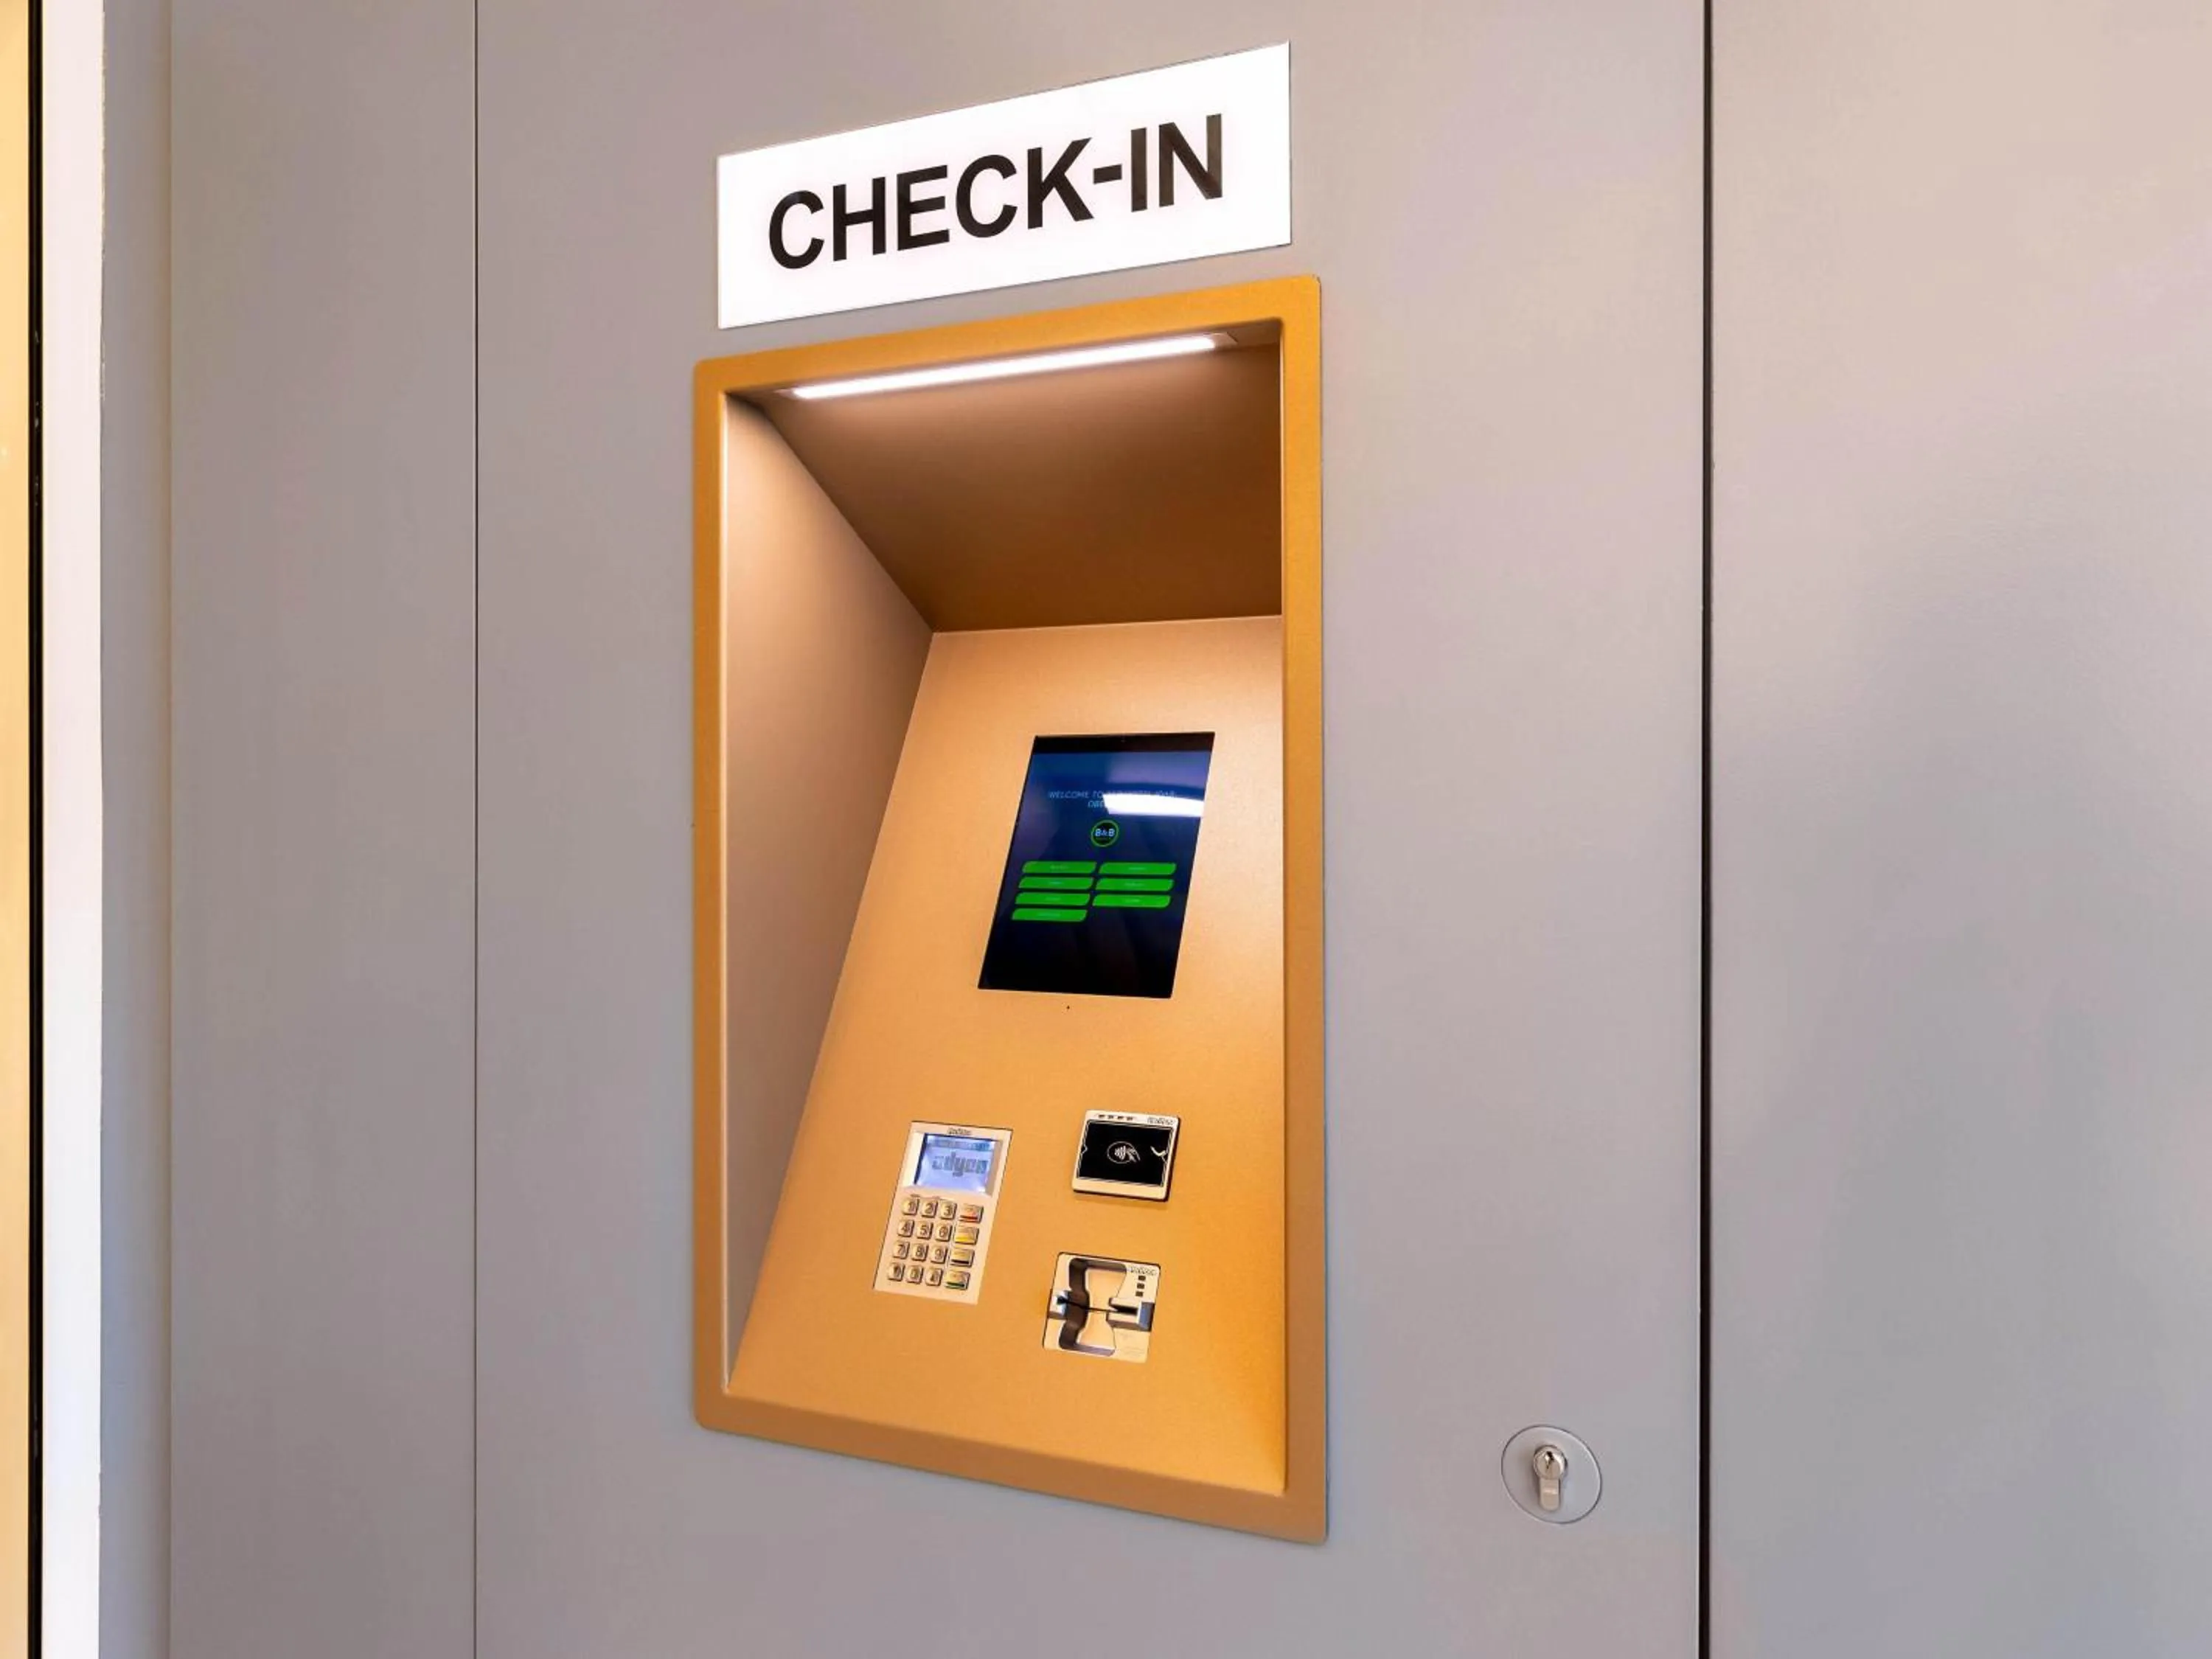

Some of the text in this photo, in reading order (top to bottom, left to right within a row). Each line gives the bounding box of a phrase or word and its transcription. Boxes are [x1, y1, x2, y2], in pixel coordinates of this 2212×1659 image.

[769, 114, 1222, 269] CHECK-IN
[1048, 790, 1090, 799] WELCOME
[1095, 828, 1116, 838] B&B
